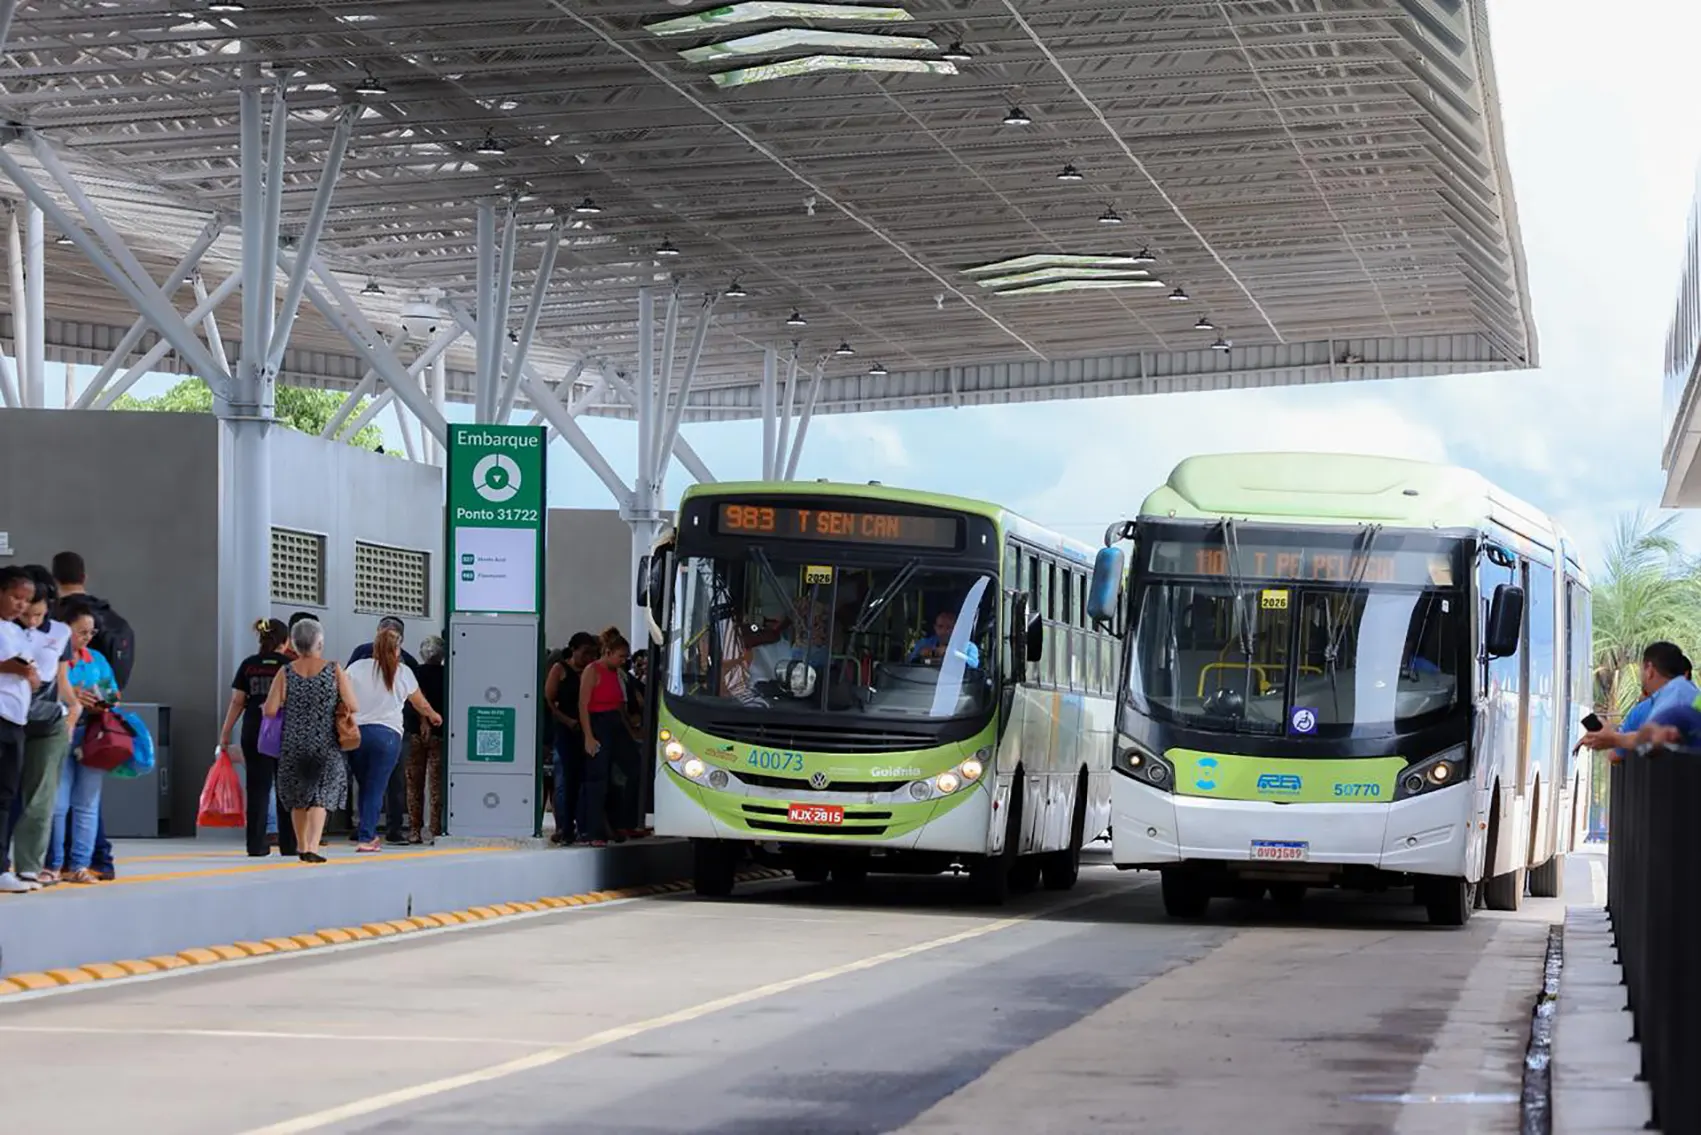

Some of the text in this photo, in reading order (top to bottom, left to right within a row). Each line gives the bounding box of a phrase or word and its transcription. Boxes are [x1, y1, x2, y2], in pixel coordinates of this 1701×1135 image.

[457, 430, 539, 450] Embarque
[457, 507, 538, 521] Ponto 31722
[725, 505, 899, 538] 983 T SEN CAN
[1255, 552, 1267, 575] T
[807, 573, 832, 584] 2026
[1262, 597, 1287, 608] 2026
[748, 749, 803, 771] 40073
[1333, 783, 1380, 796] 50770
